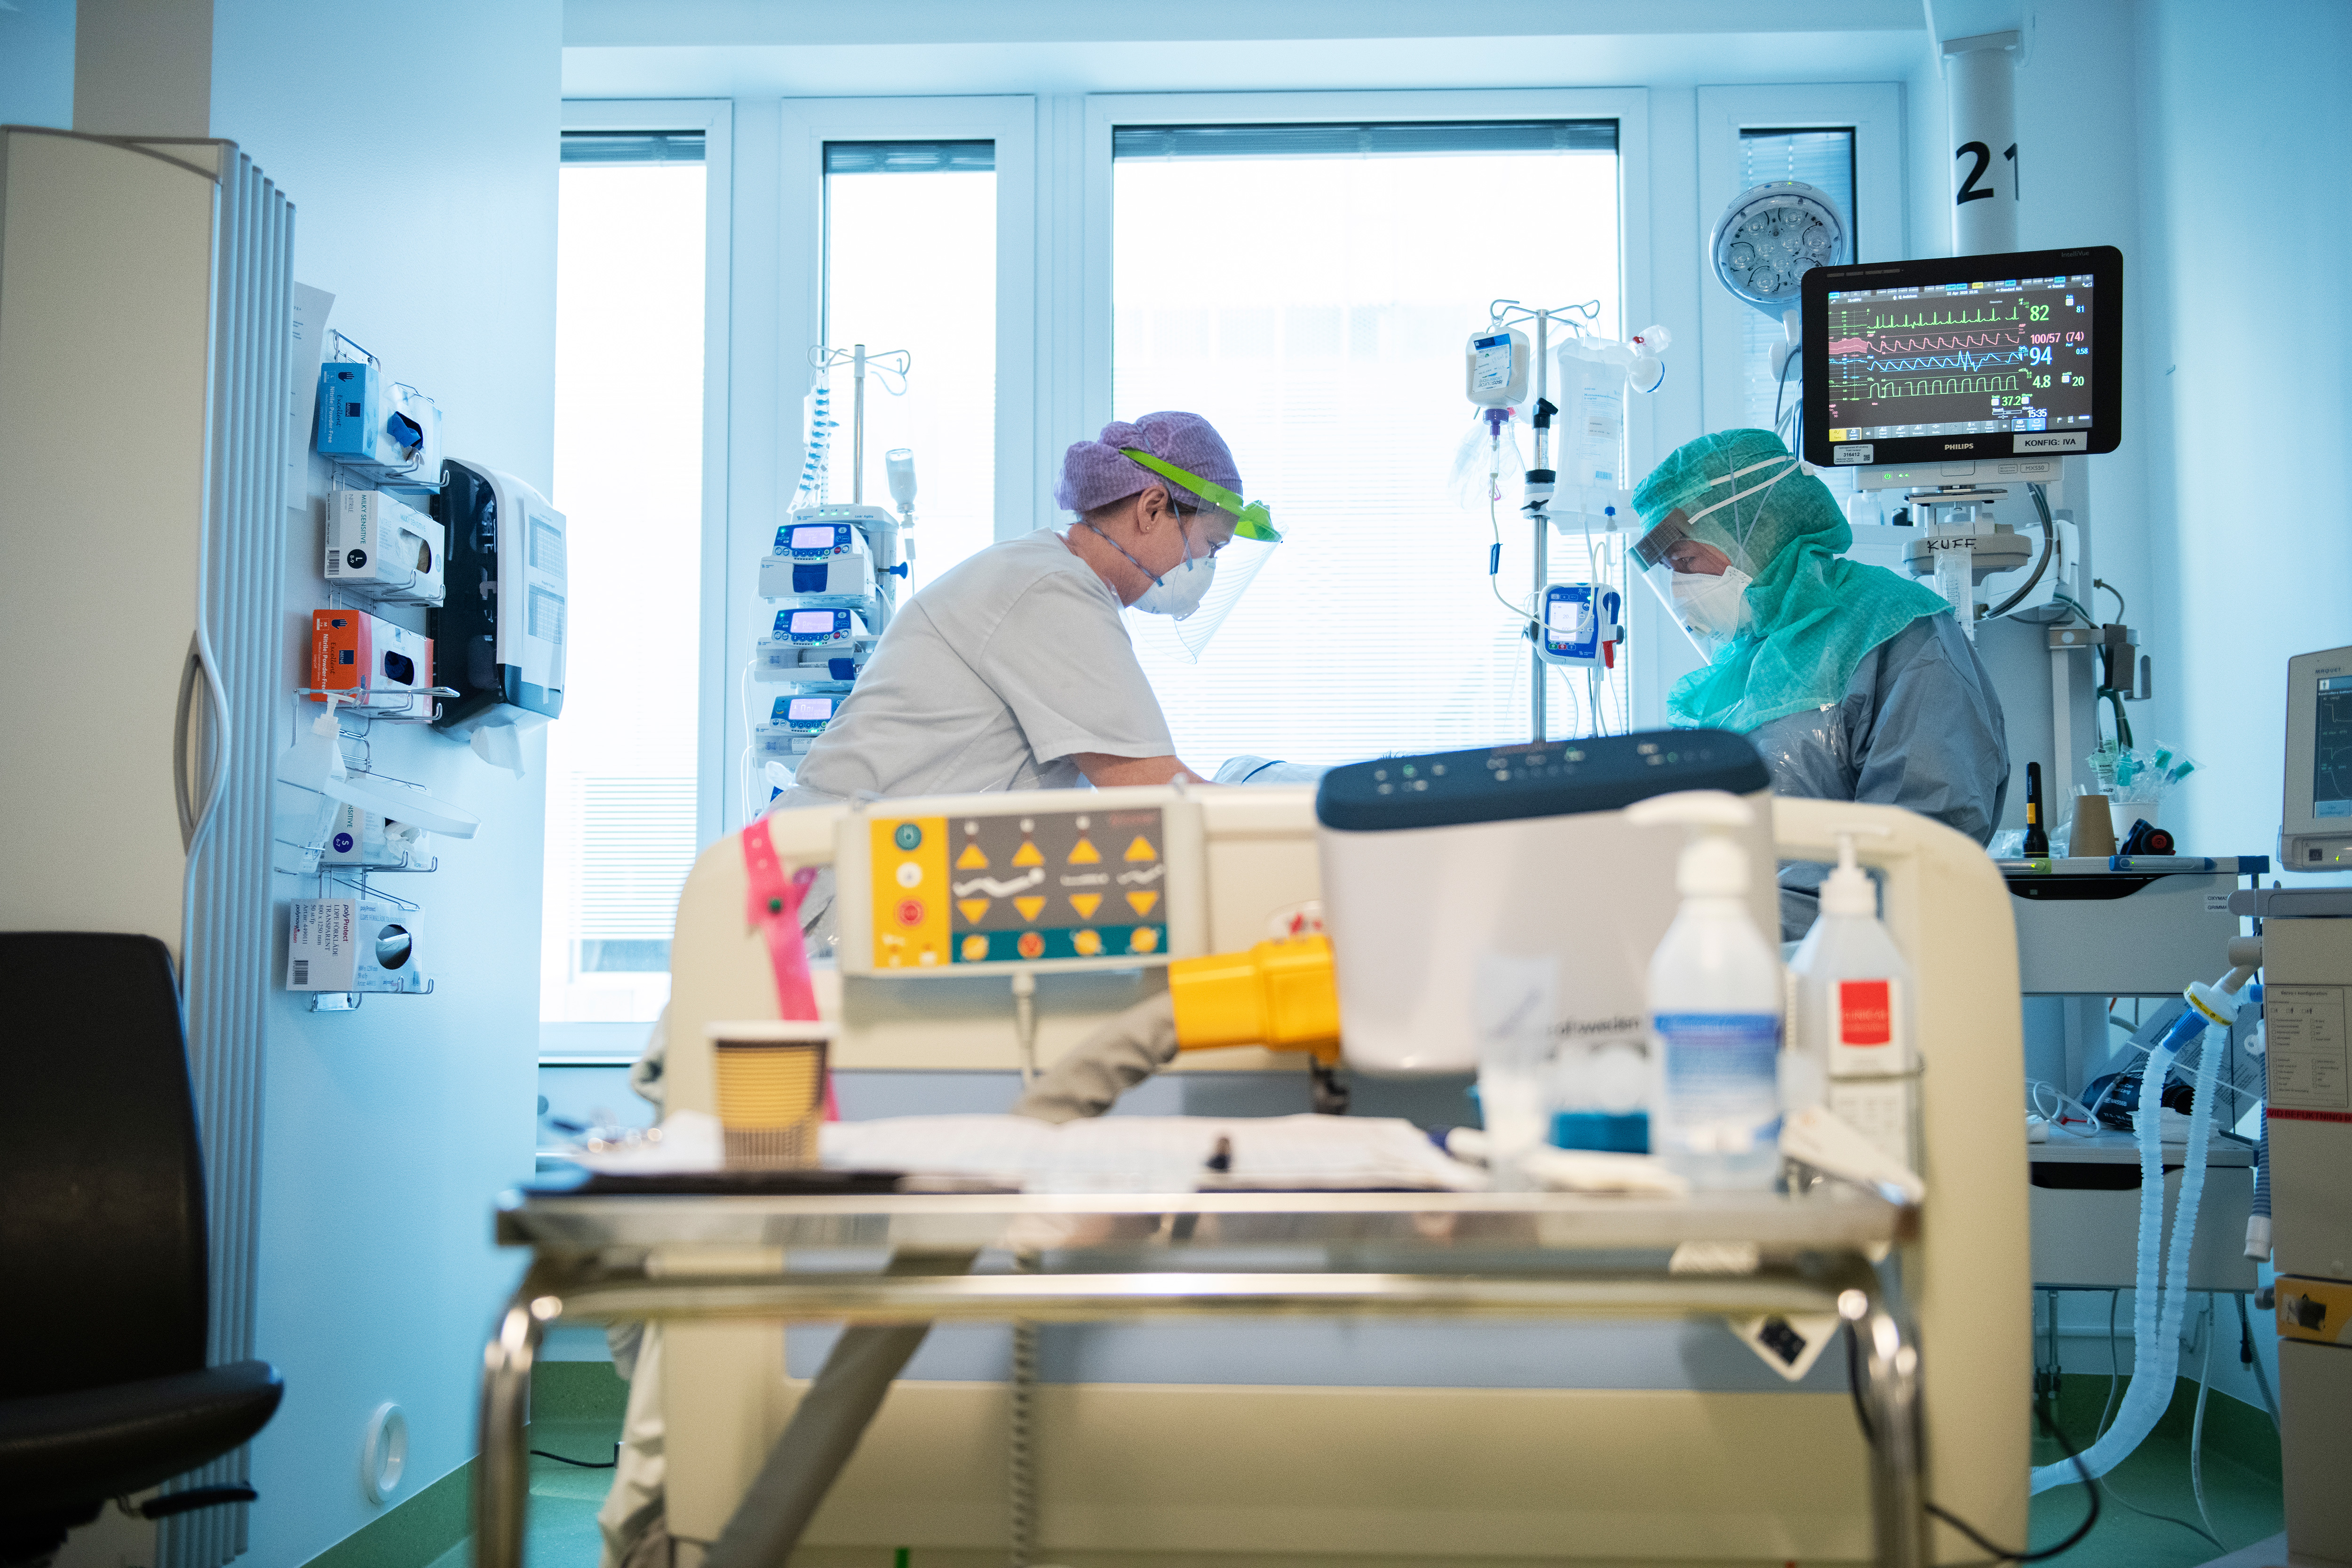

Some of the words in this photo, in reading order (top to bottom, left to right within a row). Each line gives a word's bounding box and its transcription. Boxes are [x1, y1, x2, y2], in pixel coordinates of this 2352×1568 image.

[1956, 141, 2019, 206] 21
[2030, 305, 2049, 321] 82
[2030, 333, 2061, 344] 100/57
[2066, 331, 2085, 342] (74)
[2030, 346, 2052, 366] 94
[2033, 375, 2051, 388] 4.8
[2072, 376, 2084, 387] 20
[2002, 396, 2021, 406] 37.2
[2027, 409, 2047, 418] 15:35
[401, 513, 410, 524] MILKY
[410, 518, 427, 533] SENSITIVE
[318, 936, 321, 945] mm
[2268, 1108, 2284, 1118] VID
[2284, 1110, 2342, 1122] BEFUKTNING
